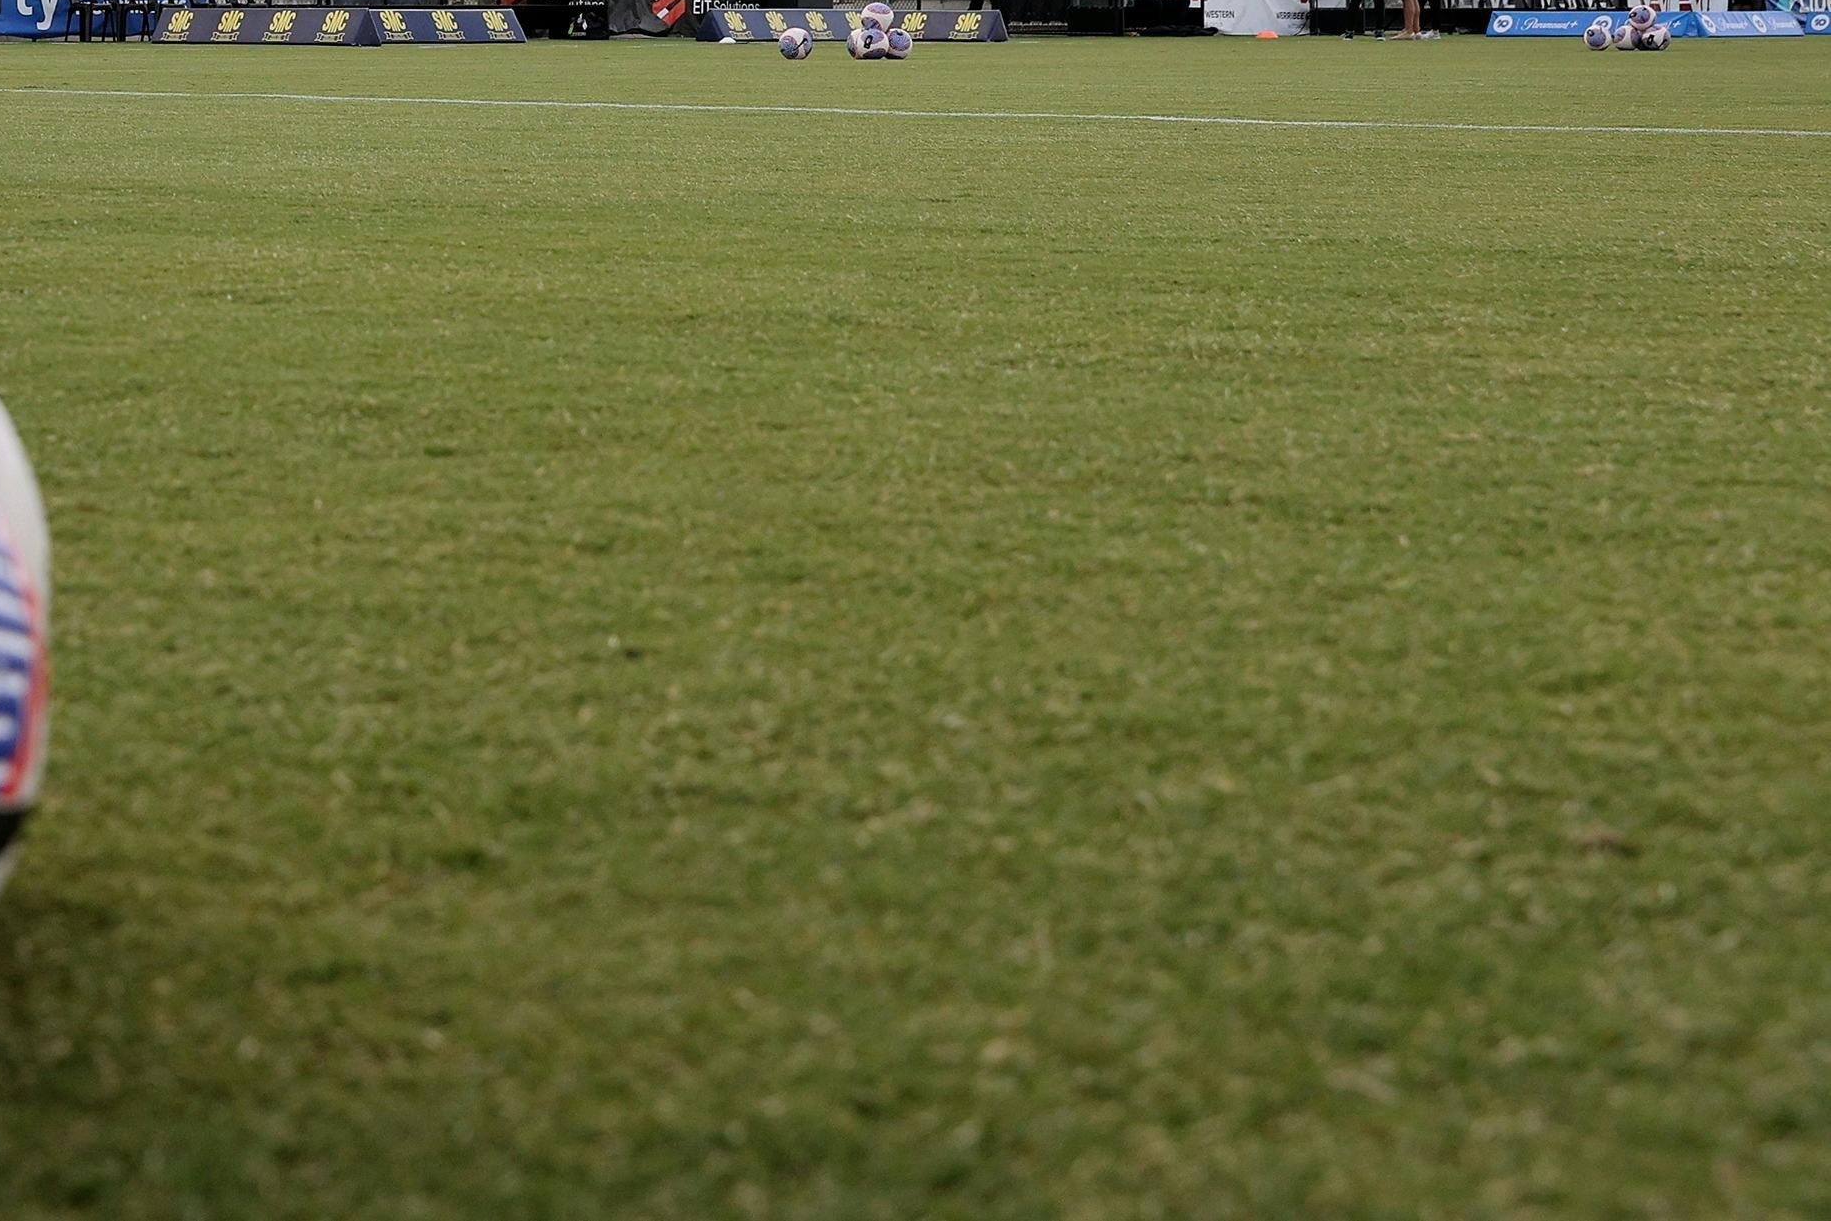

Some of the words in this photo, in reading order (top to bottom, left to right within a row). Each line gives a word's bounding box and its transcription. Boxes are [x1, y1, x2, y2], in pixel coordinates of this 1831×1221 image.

[693, 0, 711, 15] EIT
[713, 0, 760, 10] Solutions
[168, 10, 194, 32] SMC
[218, 10, 244, 32] SMC
[269, 10, 296, 32] SMC
[322, 10, 350, 33] SMC
[379, 10, 406, 31] SMC
[431, 10, 458, 31] SMC
[482, 10, 508, 31] SMC
[724, 11, 747, 31] SMC
[765, 11, 787, 31] SMC
[805, 11, 828, 31] SMC
[901, 12, 928, 32] SMC
[955, 12, 982, 32] SMC
